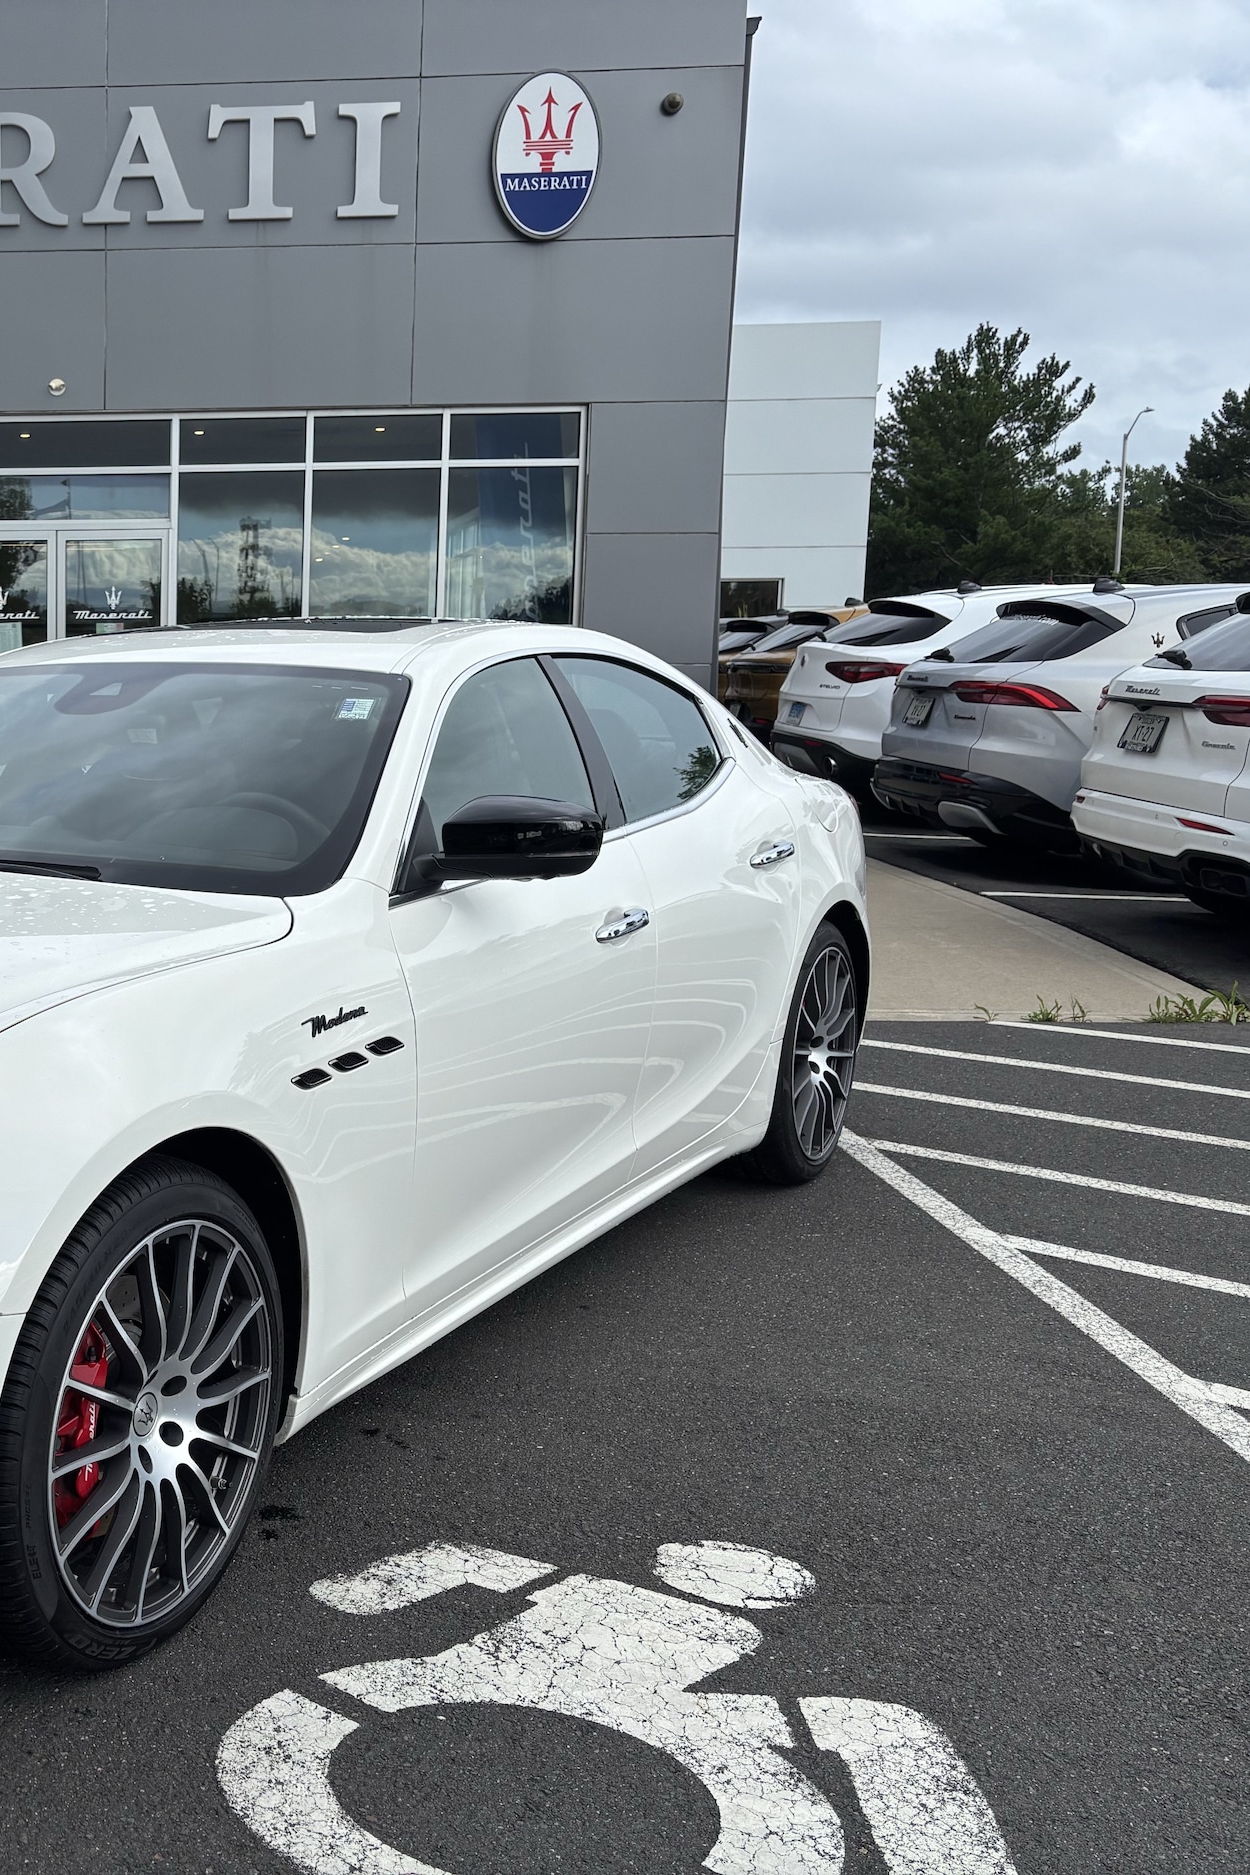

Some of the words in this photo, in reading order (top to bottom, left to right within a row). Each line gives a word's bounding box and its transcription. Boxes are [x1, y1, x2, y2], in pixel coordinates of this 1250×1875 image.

[505, 175, 587, 191] MASERATI
[72, 610, 153, 620] Maserati
[301, 1006, 369, 1038] Modena
